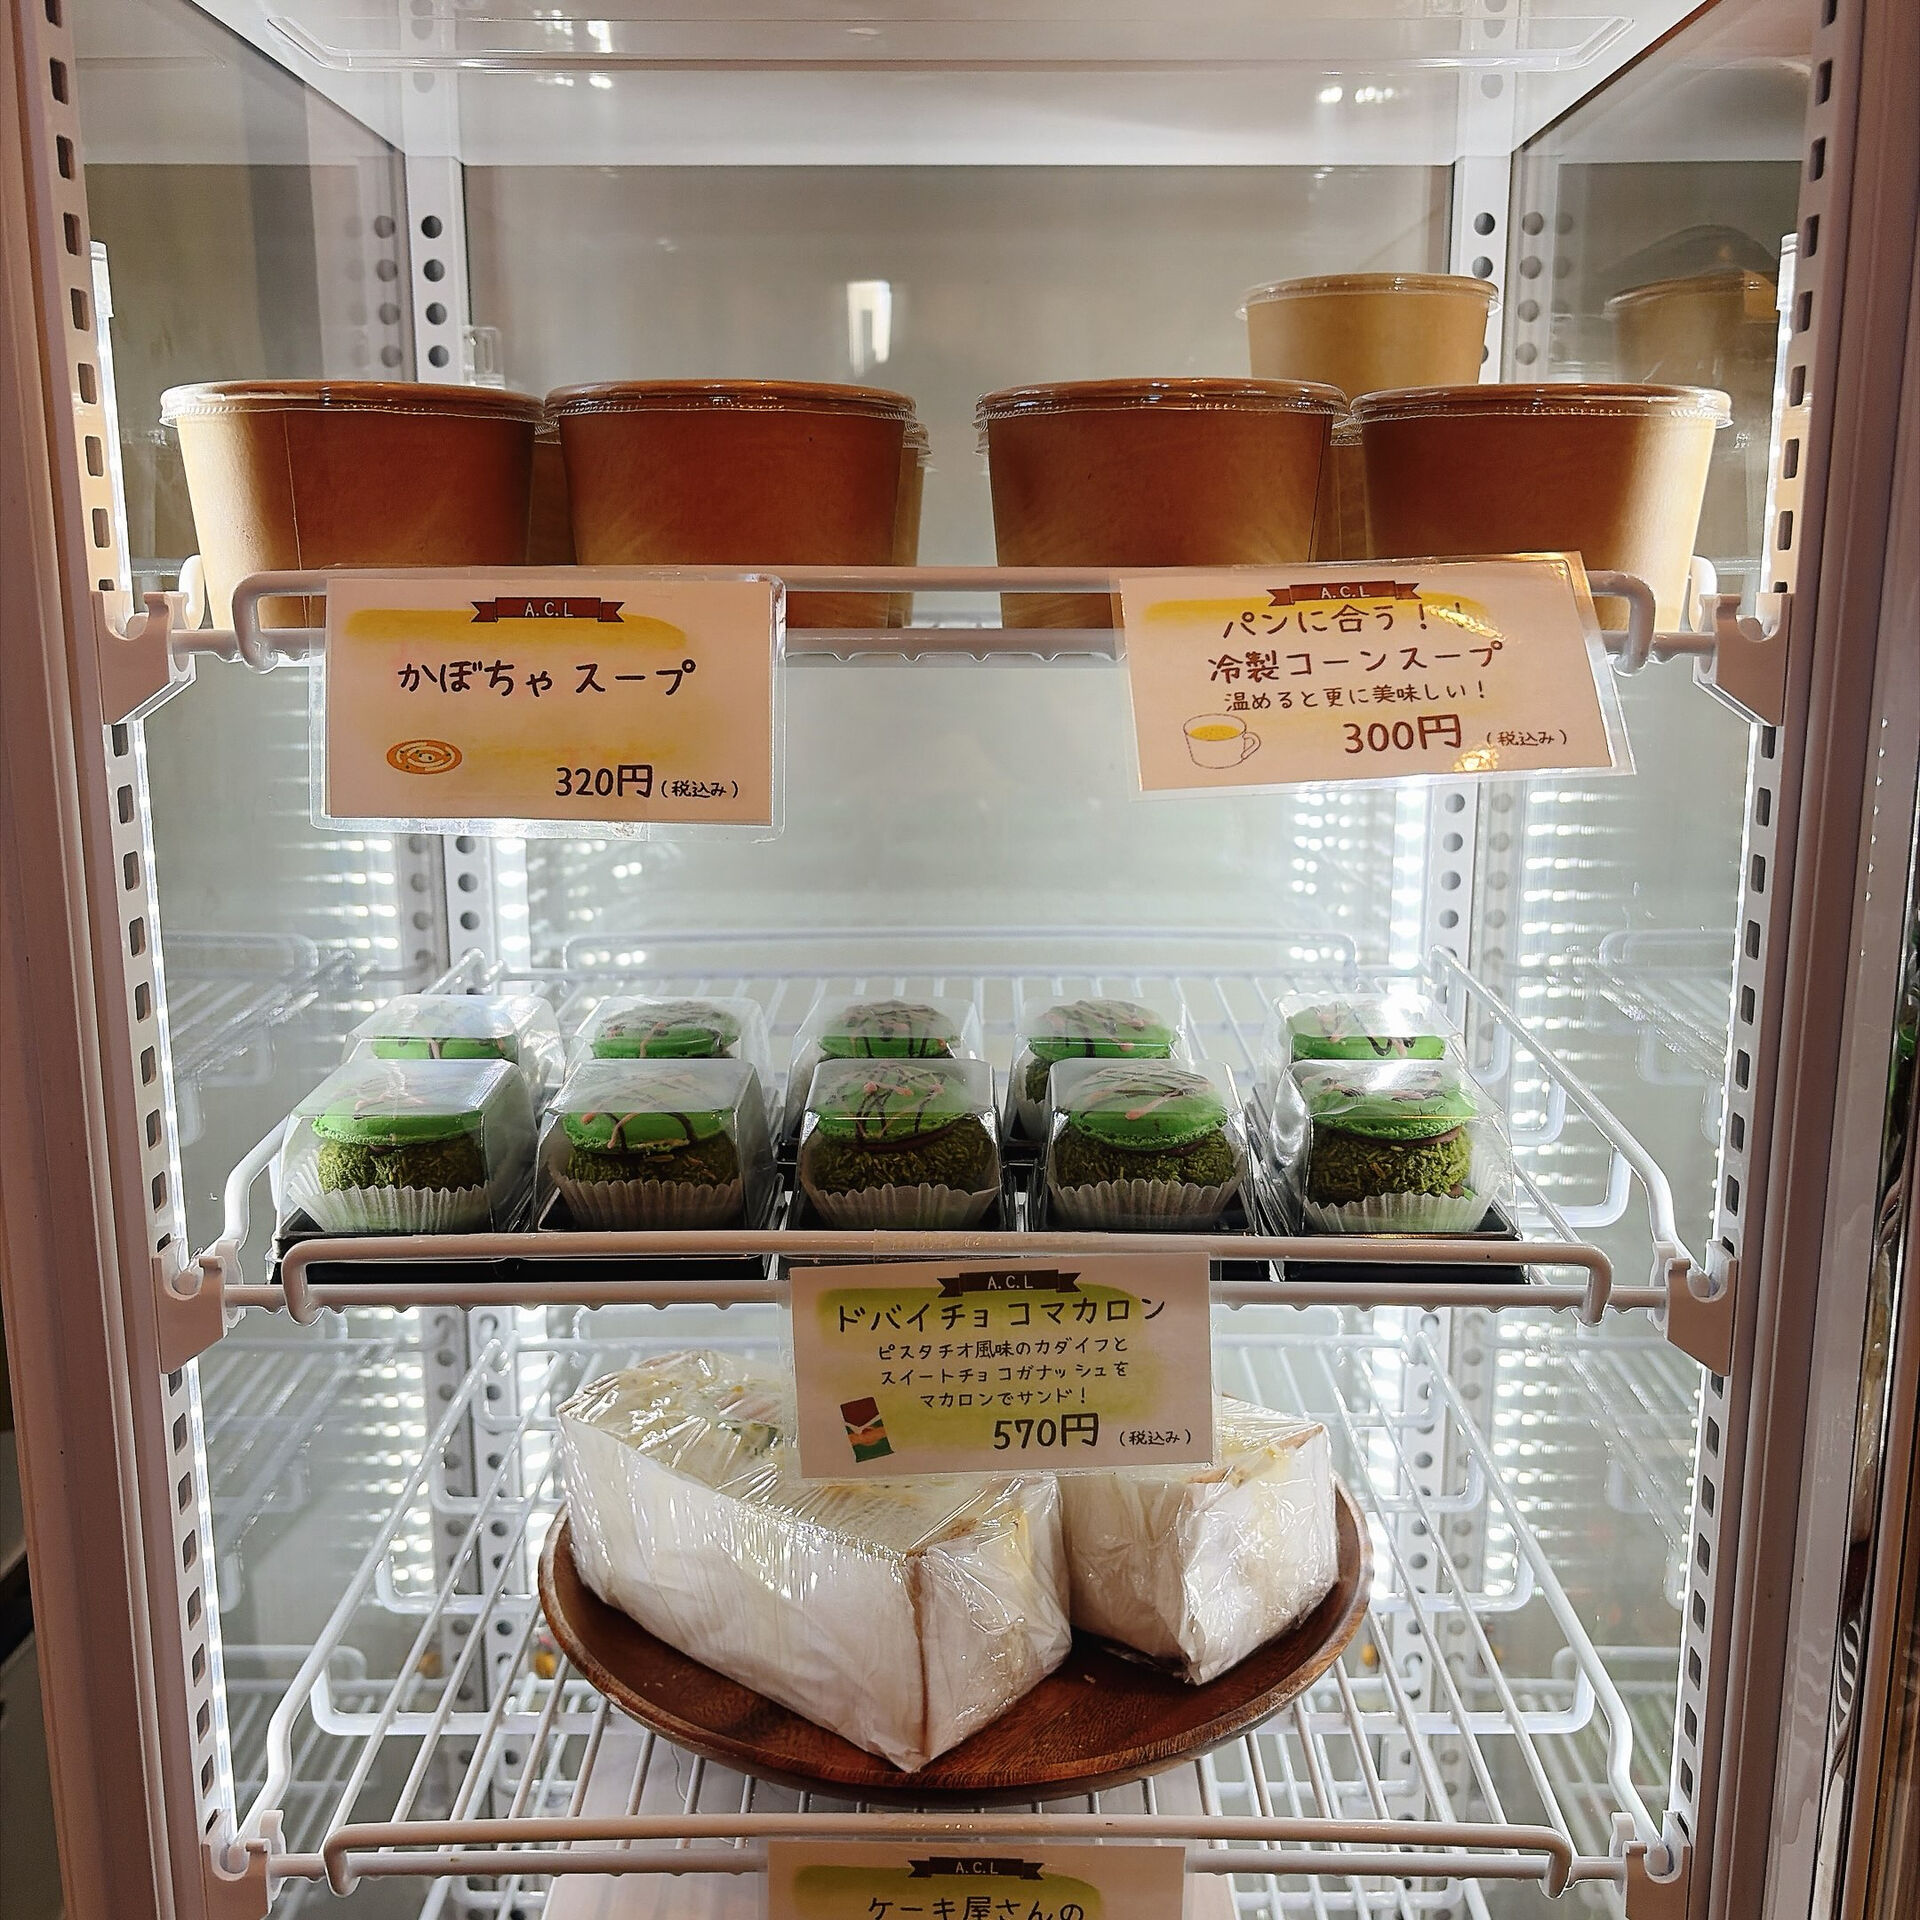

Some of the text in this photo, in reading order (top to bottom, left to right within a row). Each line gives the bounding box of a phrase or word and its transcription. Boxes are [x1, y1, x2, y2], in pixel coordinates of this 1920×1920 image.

[1320, 584, 1371, 599] A.C.L
[524, 601, 573, 618] A.C.L
[1208, 640, 1503, 683] 冷製コーンスープ
[1344, 713, 1462, 753] 300円
[555, 764, 653, 798] 320円
[987, 1275, 1034, 1290] A.C.L
[839, 1297, 1165, 1333] ドバイチョコマカロン
[879, 1337, 1128, 1361] ピスタチオ風味のカダイフと
[881, 1361, 1128, 1386] スイートチョコガナッシュを
[993, 1412, 1099, 1450] 570円
[955, 1861, 999, 1875] A.C.L
